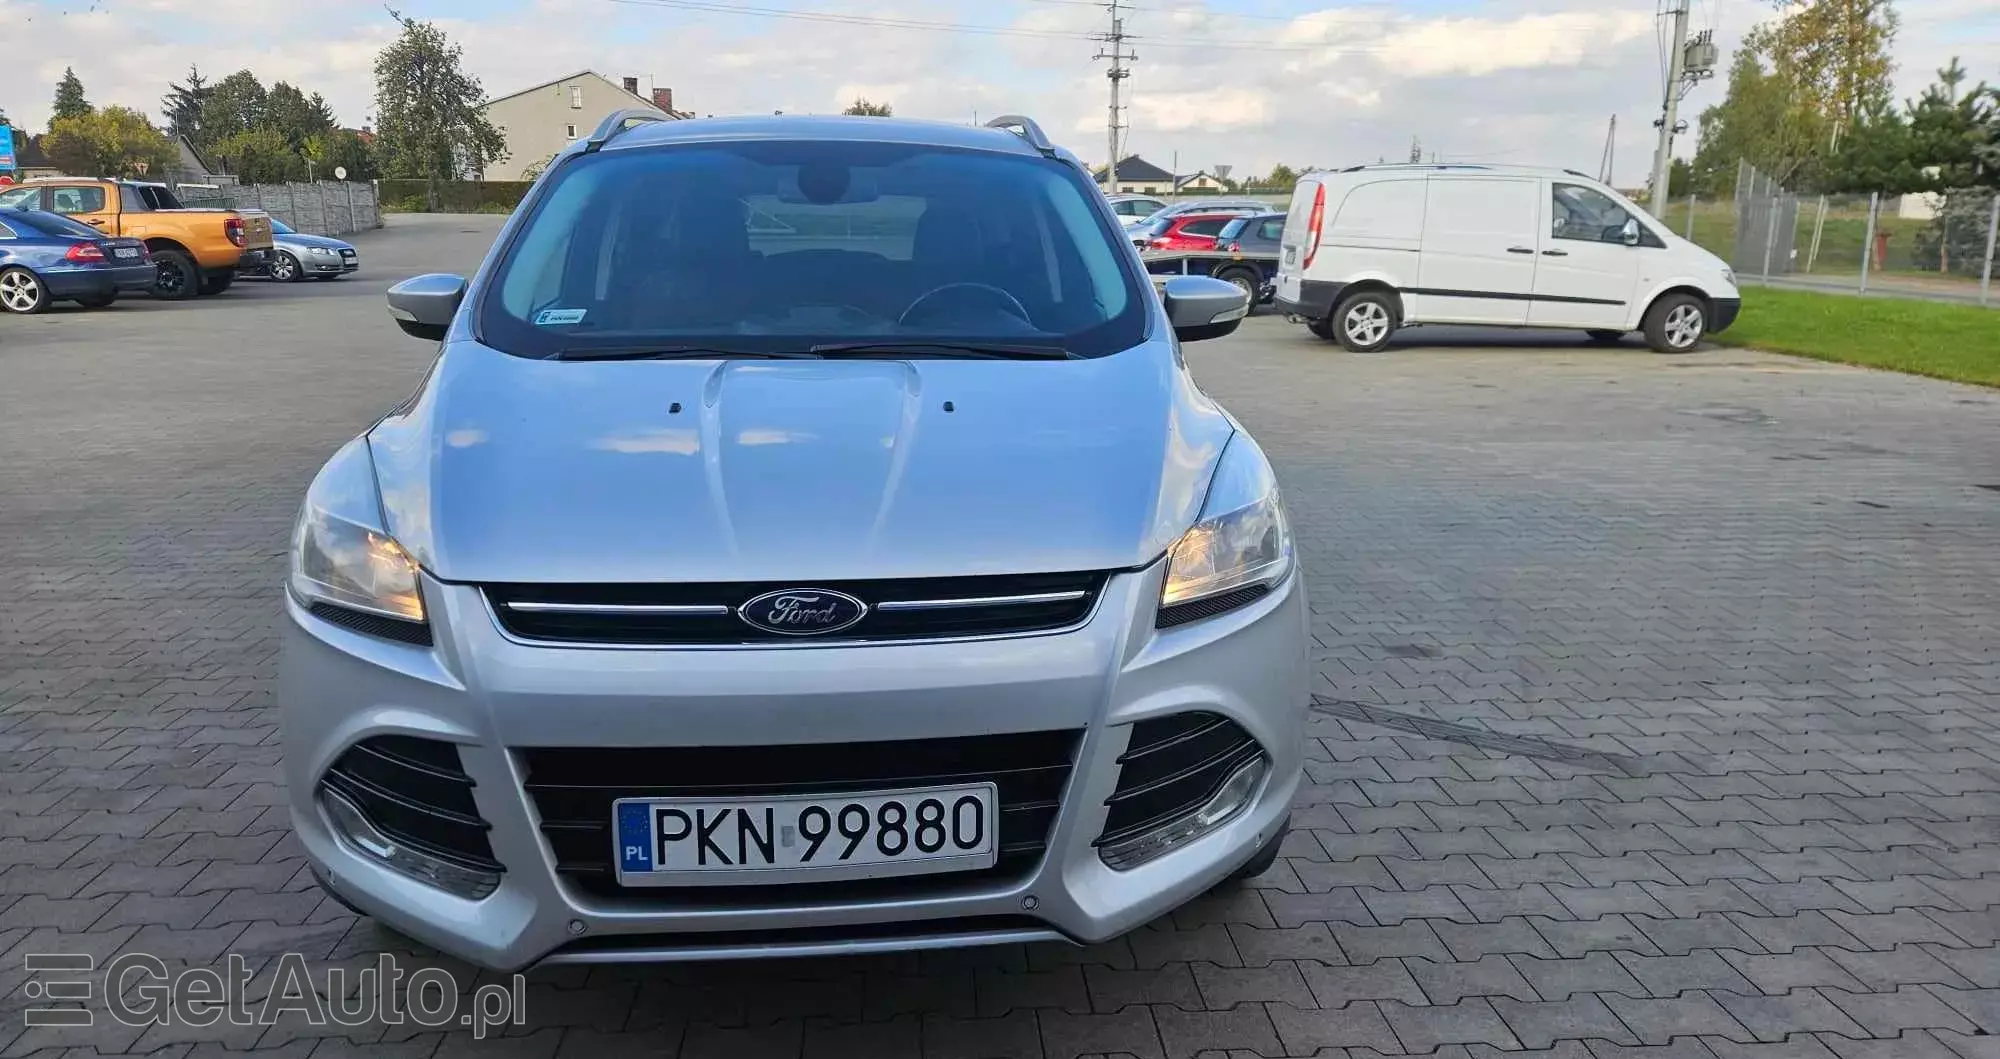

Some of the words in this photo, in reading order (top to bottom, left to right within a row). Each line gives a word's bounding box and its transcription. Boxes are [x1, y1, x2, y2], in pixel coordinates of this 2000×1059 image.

[767, 595, 837, 625] Ford
[655, 807, 776, 866] PKN
[797, 794, 984, 863] 99880
[625, 845, 649, 862] PL
